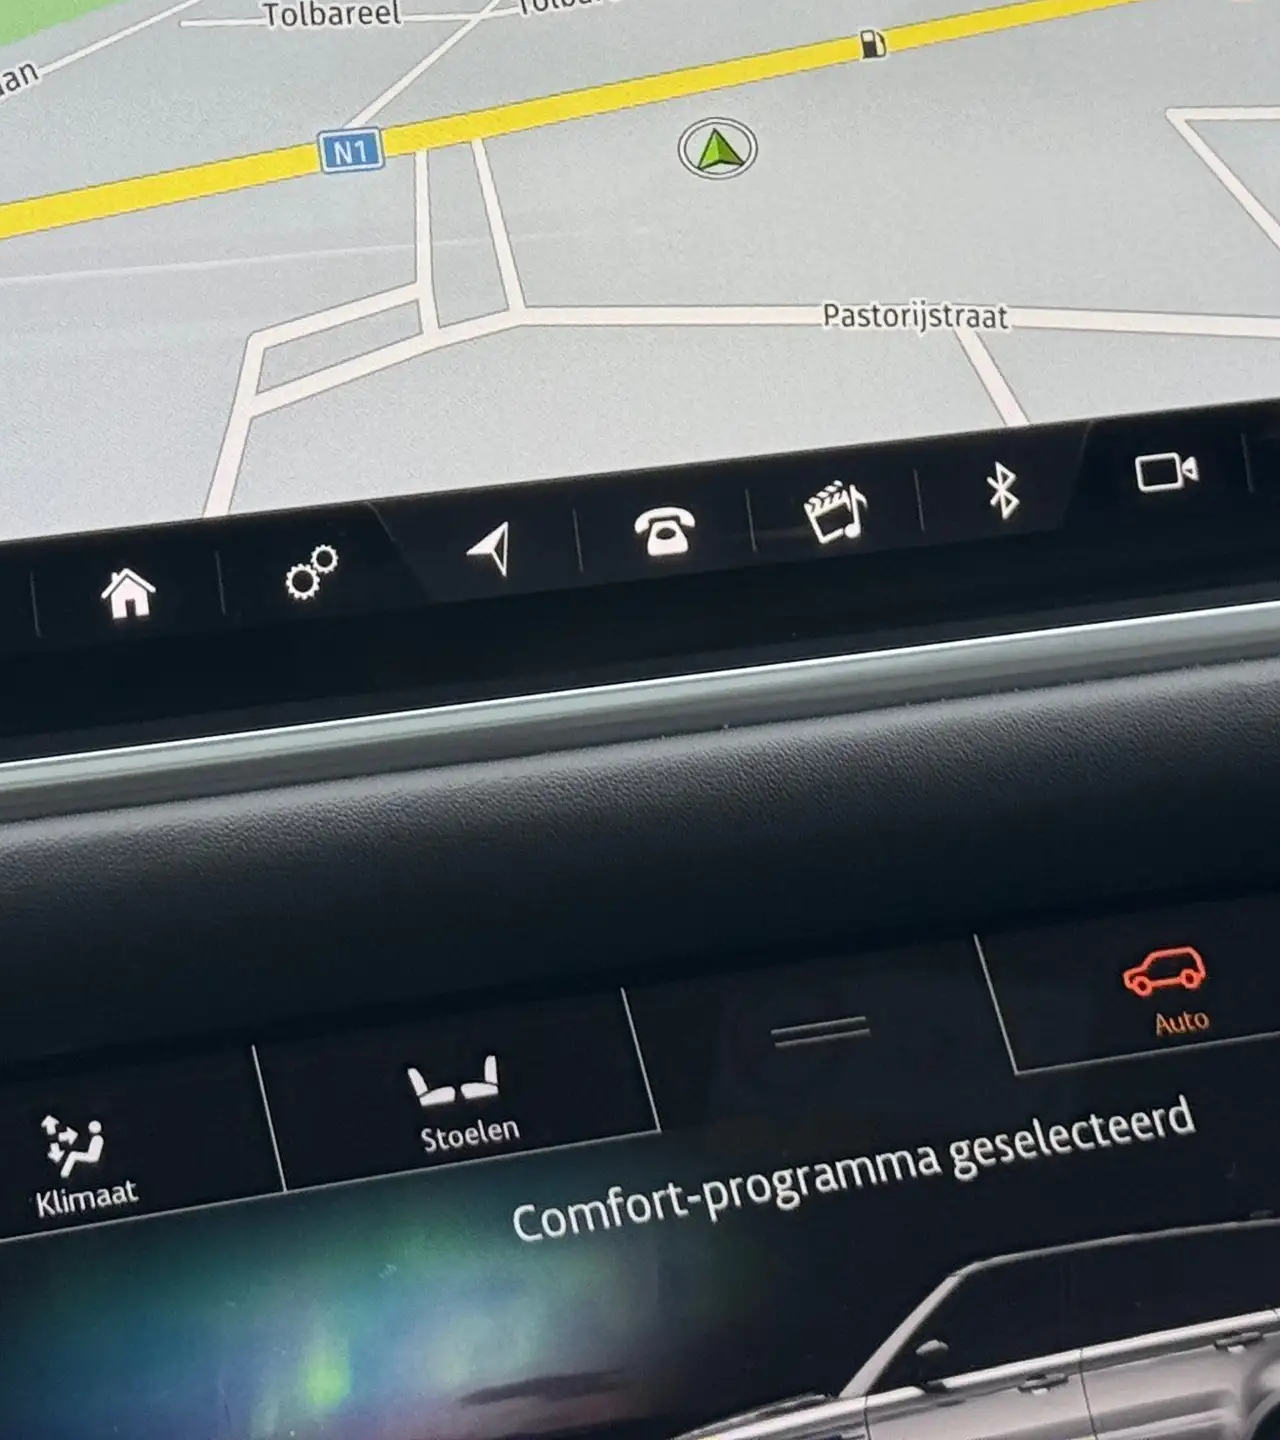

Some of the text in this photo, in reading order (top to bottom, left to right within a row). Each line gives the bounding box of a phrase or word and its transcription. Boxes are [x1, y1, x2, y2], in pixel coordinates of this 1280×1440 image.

[263, 0, 402, 28] Tolbareel
[333, 139, 369, 164] N1
[823, 300, 1009, 335] Pastorijstraat
[1154, 1007, 1210, 1036] Auto
[421, 1117, 519, 1152] Stoelen
[512, 1094, 1198, 1245] Comfort-programma geselecteerd
[36, 1179, 138, 1219] Klimaat
